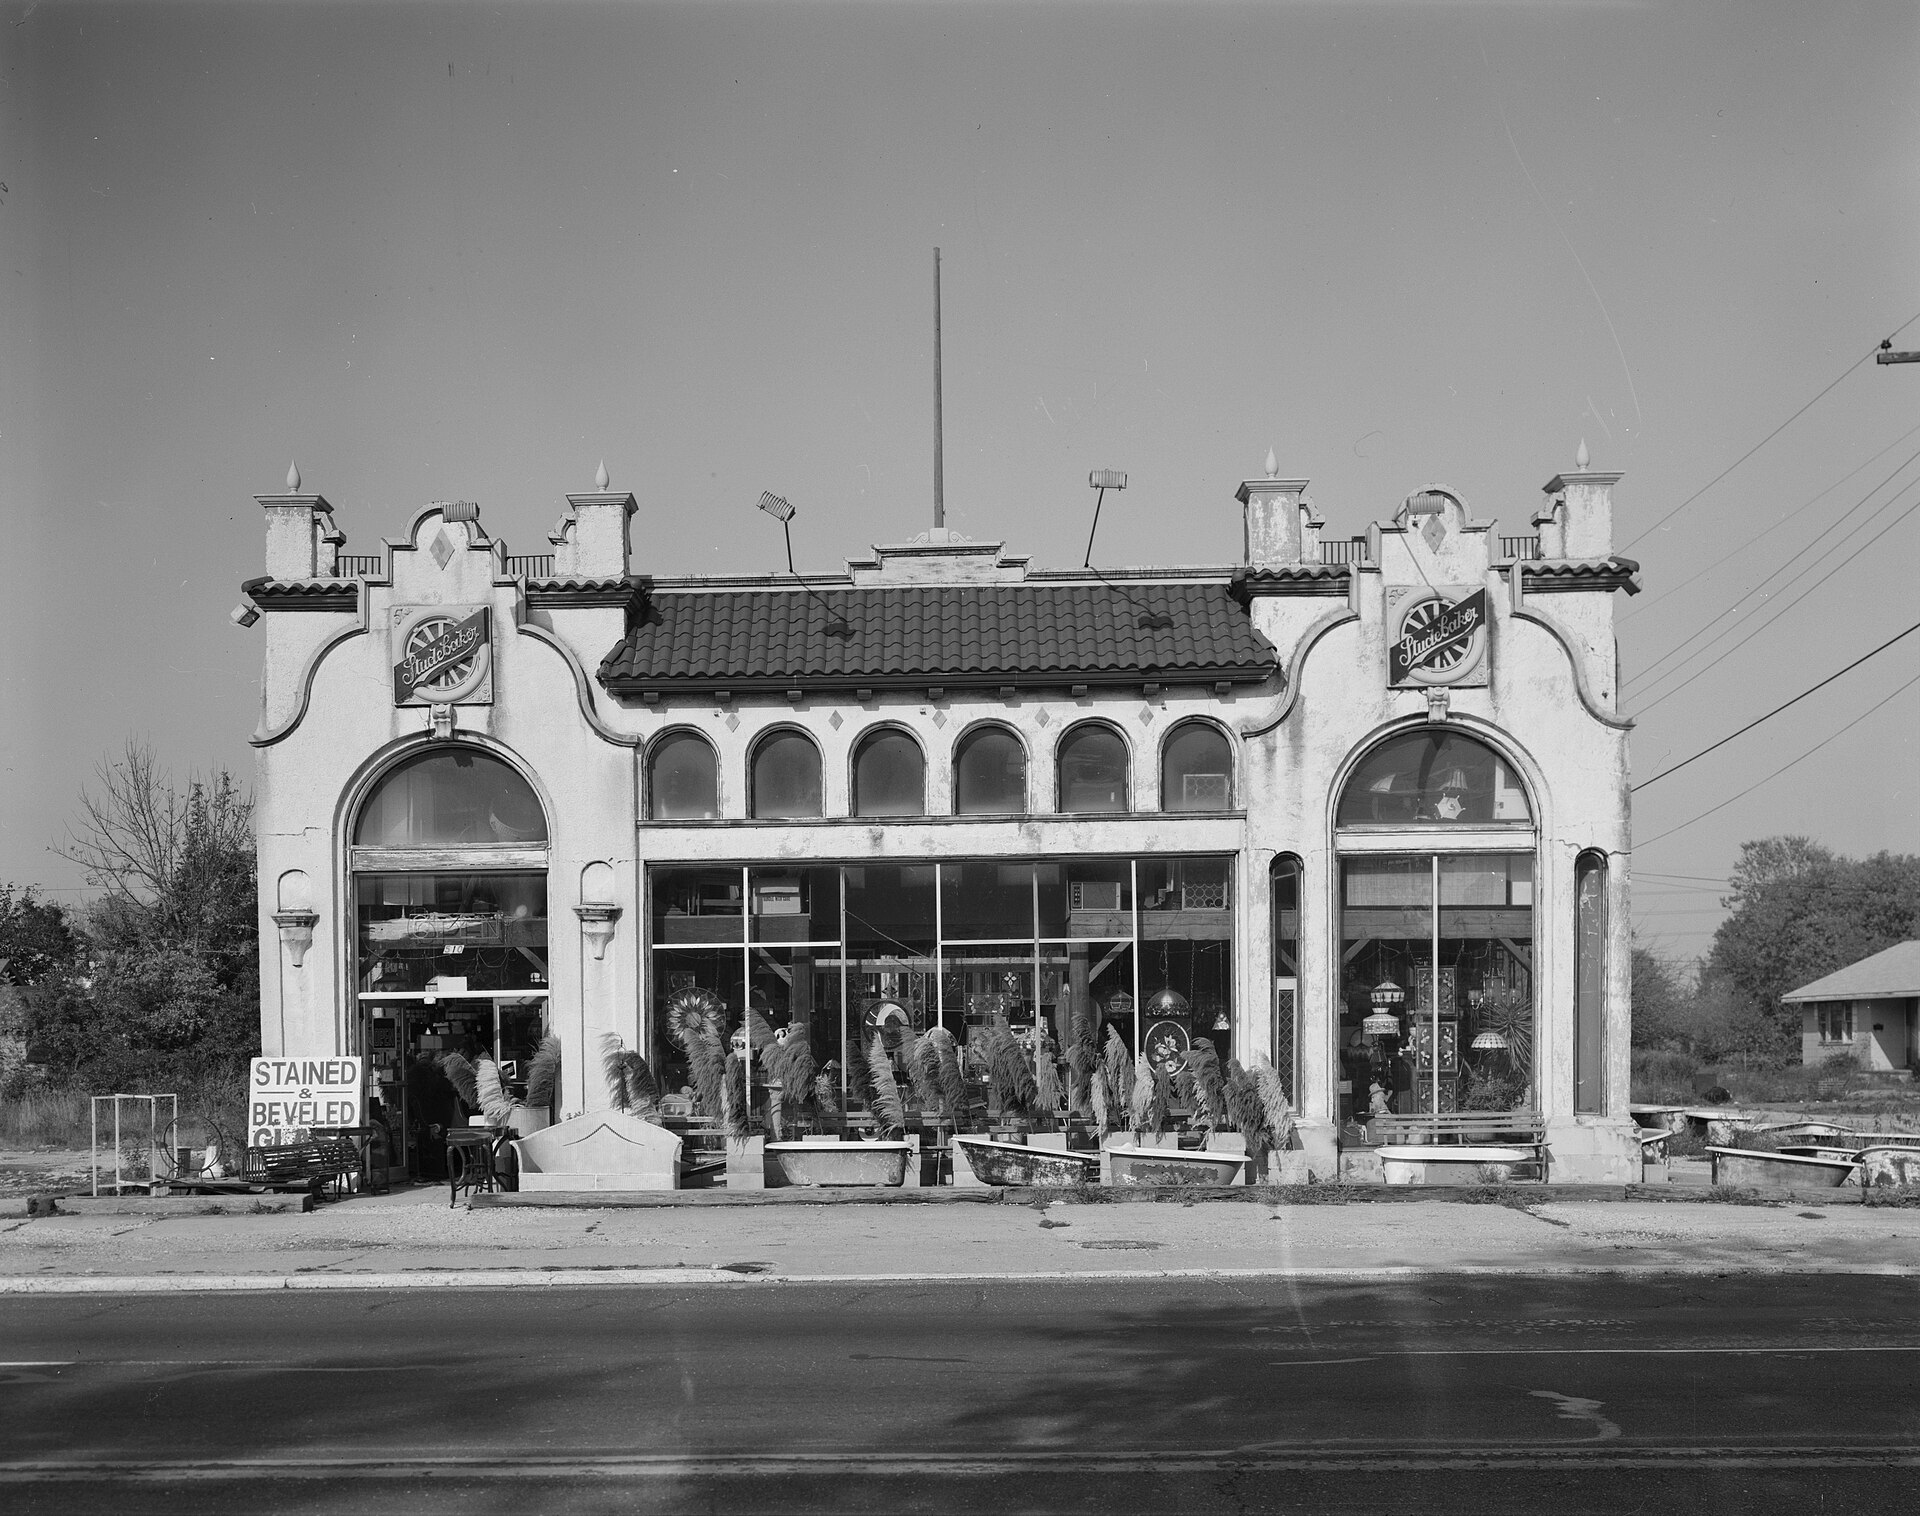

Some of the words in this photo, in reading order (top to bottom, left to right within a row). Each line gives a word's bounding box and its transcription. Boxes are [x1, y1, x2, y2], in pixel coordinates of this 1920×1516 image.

[1399, 607, 1478, 666] Studebaker
[402, 626, 479, 685] Studebaker
[255, 1061, 357, 1086] STAINED
[298, 1088, 312, 1099] &
[252, 1101, 356, 1127] BEVELED
